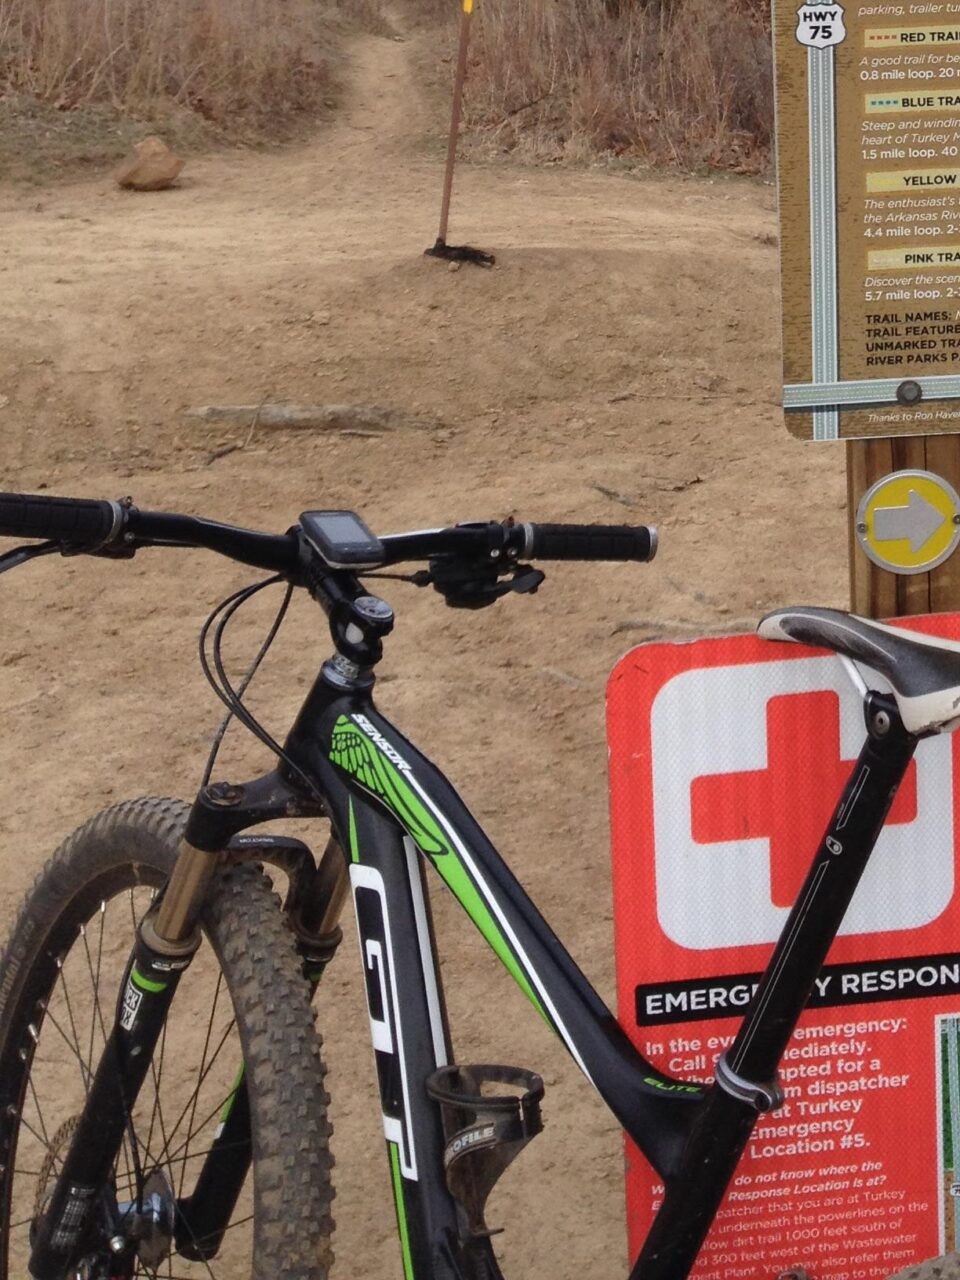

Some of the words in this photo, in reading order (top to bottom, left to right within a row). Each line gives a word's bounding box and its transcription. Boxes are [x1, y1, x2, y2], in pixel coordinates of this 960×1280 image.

[802, 10, 838, 23] HWY
[857, 4, 906, 17] parking,
[909, 2, 944, 14] trailer
[809, 25, 833, 40] 75
[900, 32, 926, 43] RED
[859, 69, 879, 81] 0.8
[881, 69, 906, 80] mile
[907, 68, 937, 80] loop.
[938, 67, 955, 78] 20
[901, 96, 935, 108] BLUE
[903, 174, 957, 186] YELLOW
[904, 253, 934, 264] PINK
[350, 713, 413, 772] SENSOR
[645, 975, 833, 1016] EMERGY
[349, 863, 419, 1182] GT
[646, 1041, 664, 1056] In
[669, 1038, 702, 1053] the
[793, 1017, 907, 1040] emergency:
[668, 1054, 706, 1073] Call
[836, 1058, 865, 1074] for
[869, 1058, 881, 1071] a
[807, 1073, 910, 1096] dispatcher
[771, 1103, 792, 1119] at
[795, 1098, 863, 1116] Turkey
[750, 1138, 835, 1159] Location
[839, 1133, 871, 1149] #5.
